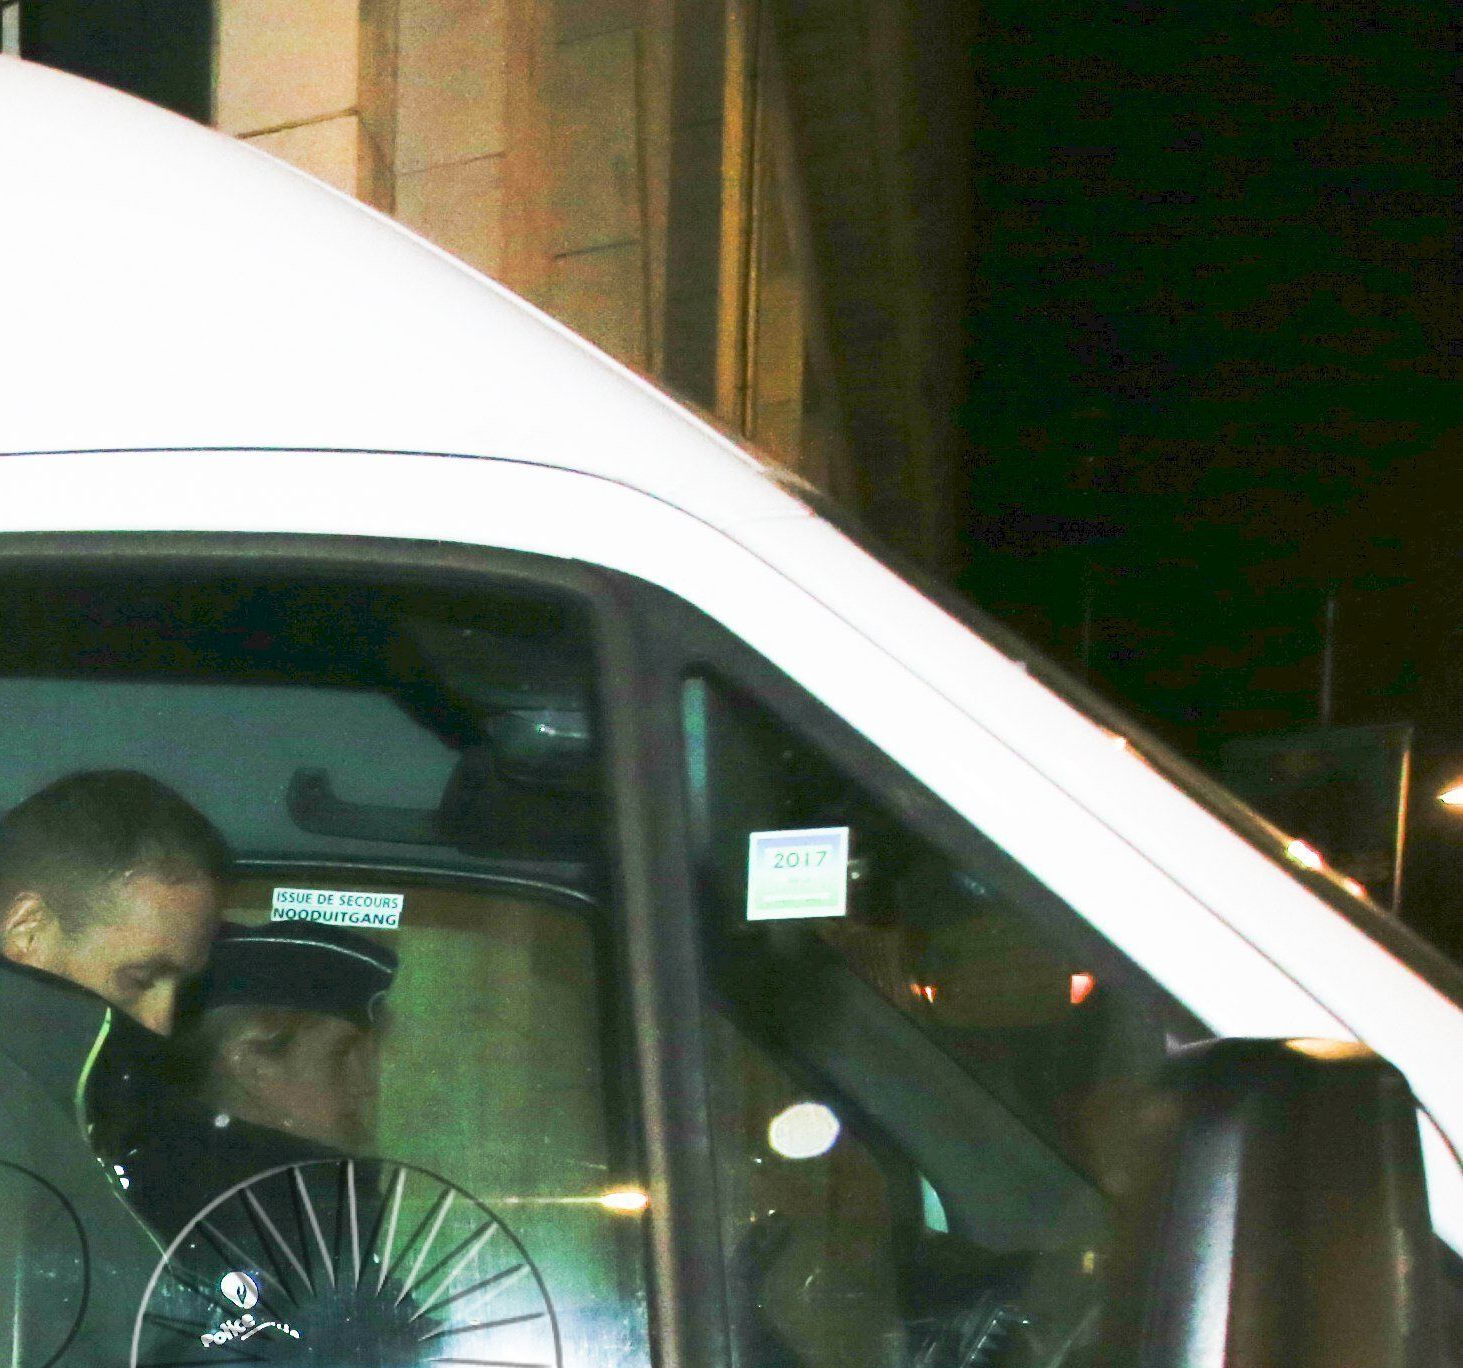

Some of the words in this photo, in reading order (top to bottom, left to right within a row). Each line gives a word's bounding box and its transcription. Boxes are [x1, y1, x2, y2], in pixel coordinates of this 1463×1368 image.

[774, 850, 828, 869] 2017
[276, 891, 313, 904] ISSUE
[317, 894, 334, 905] DE
[339, 894, 399, 909] SECOURS
[273, 907, 397, 926] NOODUITGANG
